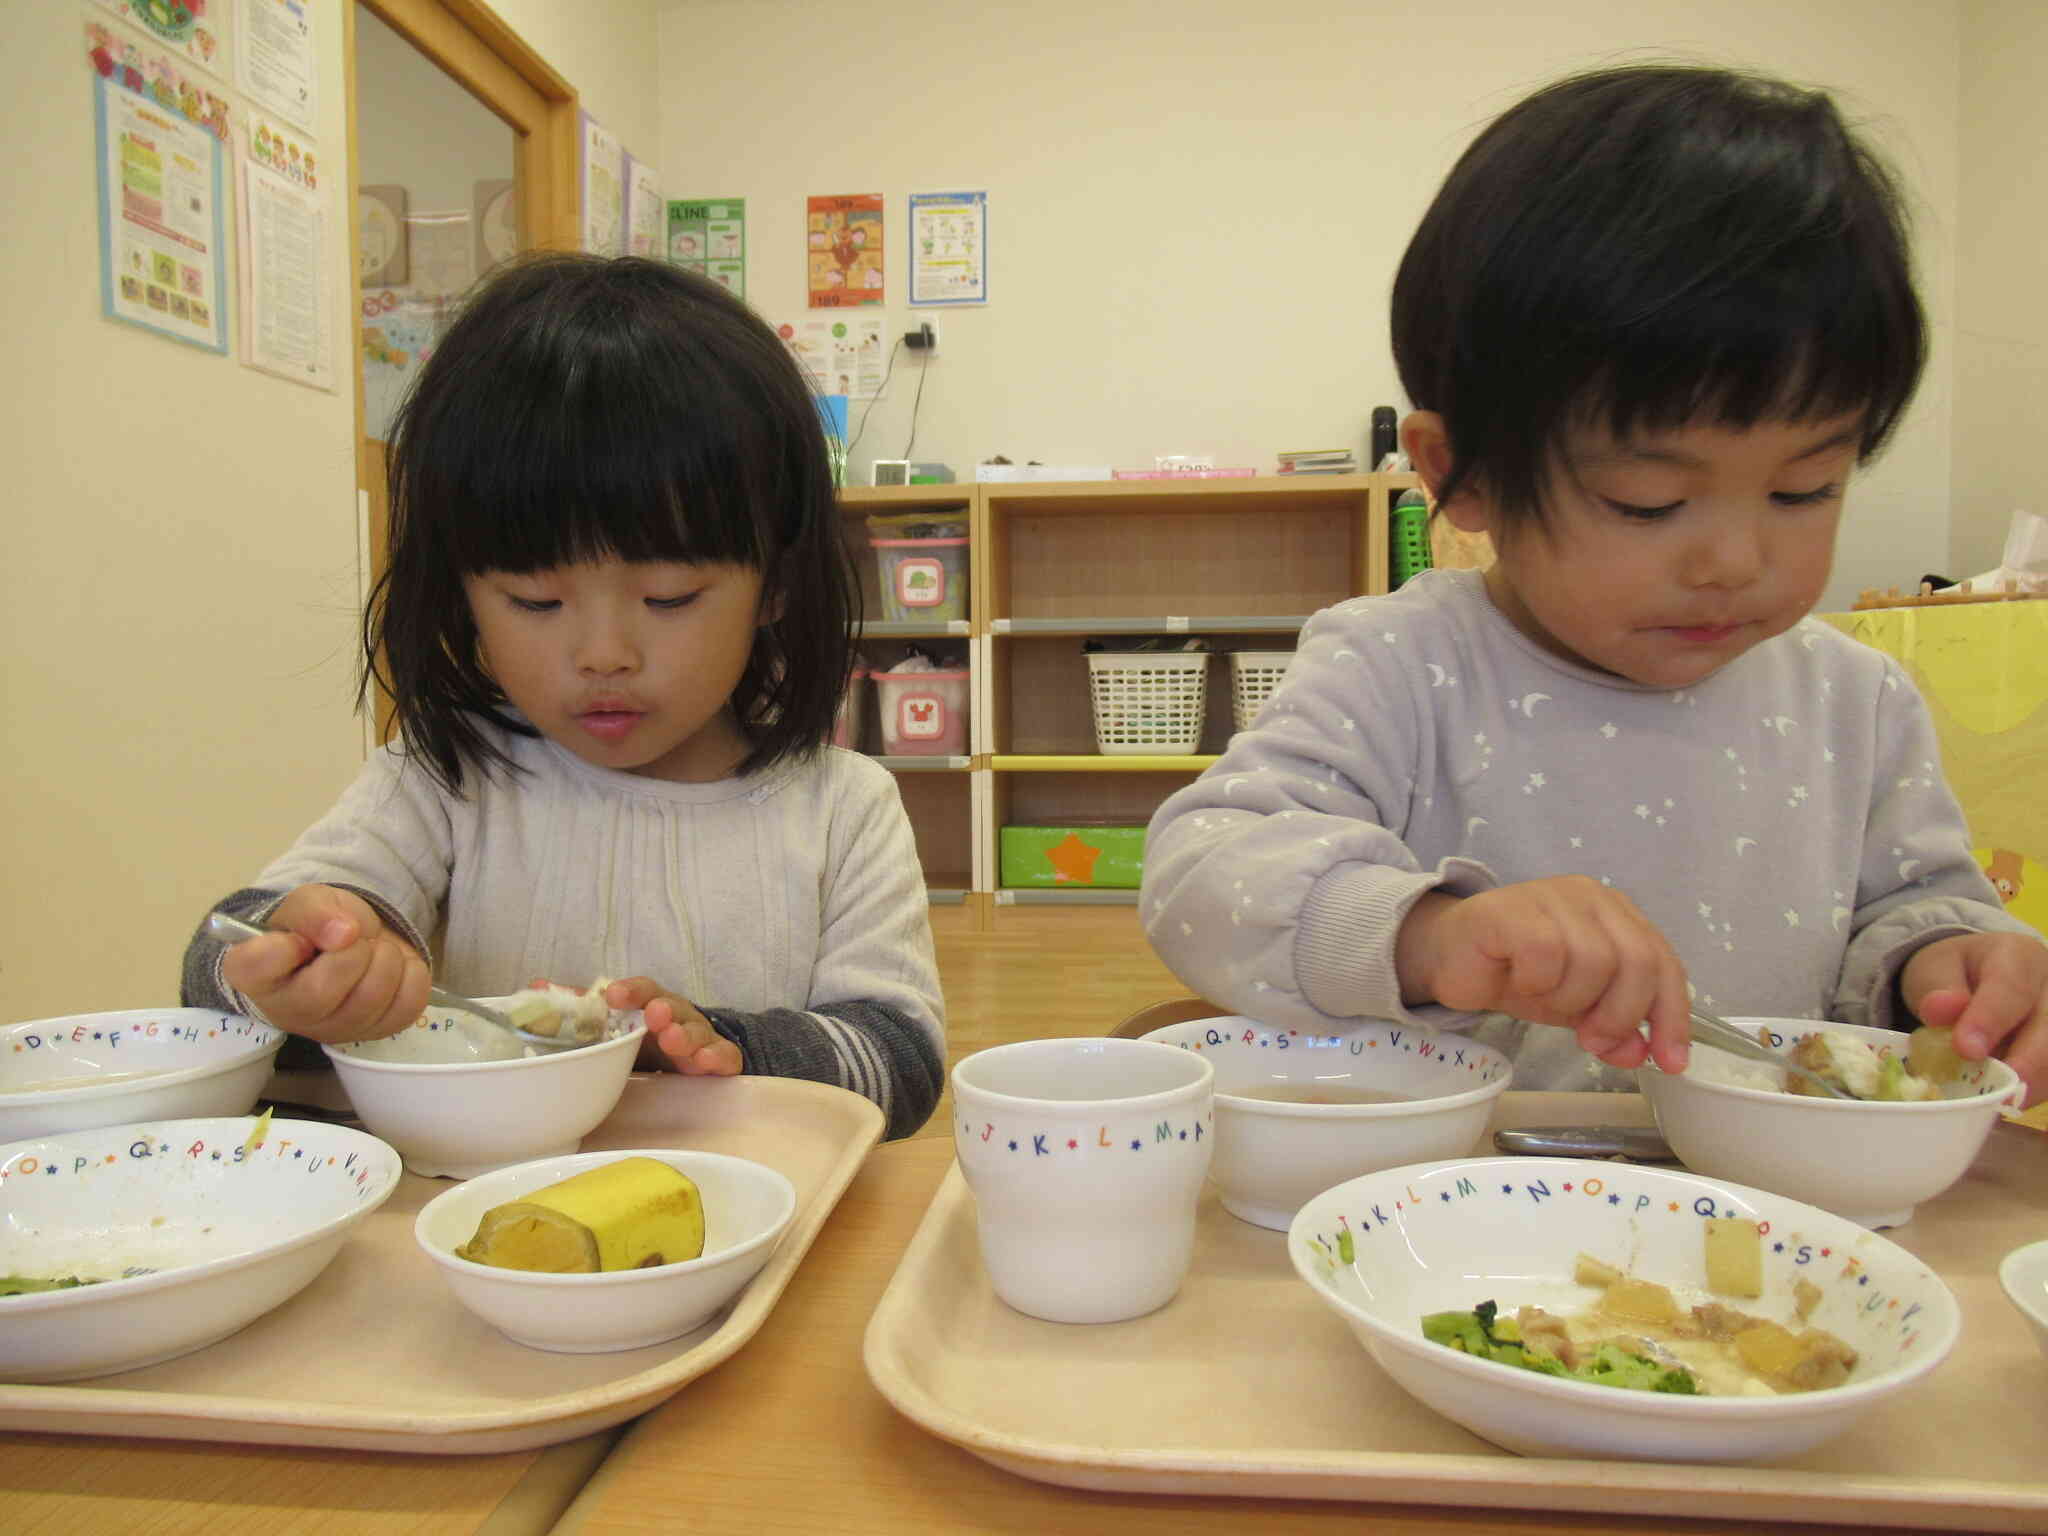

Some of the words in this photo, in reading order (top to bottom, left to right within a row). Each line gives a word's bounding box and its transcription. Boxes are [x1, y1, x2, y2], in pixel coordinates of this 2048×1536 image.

[24, 1035, 41, 1049] D
[71, 1026, 88, 1042] E
[109, 1032, 120, 1048] F
[146, 1022, 158, 1037] G
[184, 1026, 199, 1043] H
[220, 1017, 228, 1032] I
[445, 1018, 454, 1032] P
[1206, 1030, 1222, 1045] Q
[1242, 1030, 1254, 1044] R
[1277, 1033, 1289, 1048] S
[1351, 1041, 1363, 1055] U
[1391, 1032, 1401, 1046] V
[1419, 1040, 1435, 1057] W
[1454, 1050, 1464, 1066] X
[981, 1123, 995, 1142] J
[1034, 1135, 1049, 1155] K
[1099, 1127, 1112, 1147] L
[1156, 1121, 1172, 1143] M
[19, 1158, 38, 1174] O
[75, 1157, 87, 1174] P
[130, 1141, 152, 1158] Q
[187, 1140, 204, 1158] R
[233, 1146, 245, 1162] S
[278, 1141, 291, 1158] T
[308, 1156, 323, 1173] U
[1371, 1205, 1388, 1225] K
[1407, 1184, 1422, 1203] L
[1456, 1177, 1477, 1198] M
[1527, 1179, 1551, 1203] N
[1583, 1178, 1603, 1196] O
[1635, 1194, 1650, 1212] P
[1694, 1197, 1716, 1218] Q
[1795, 1246, 1812, 1264] S
